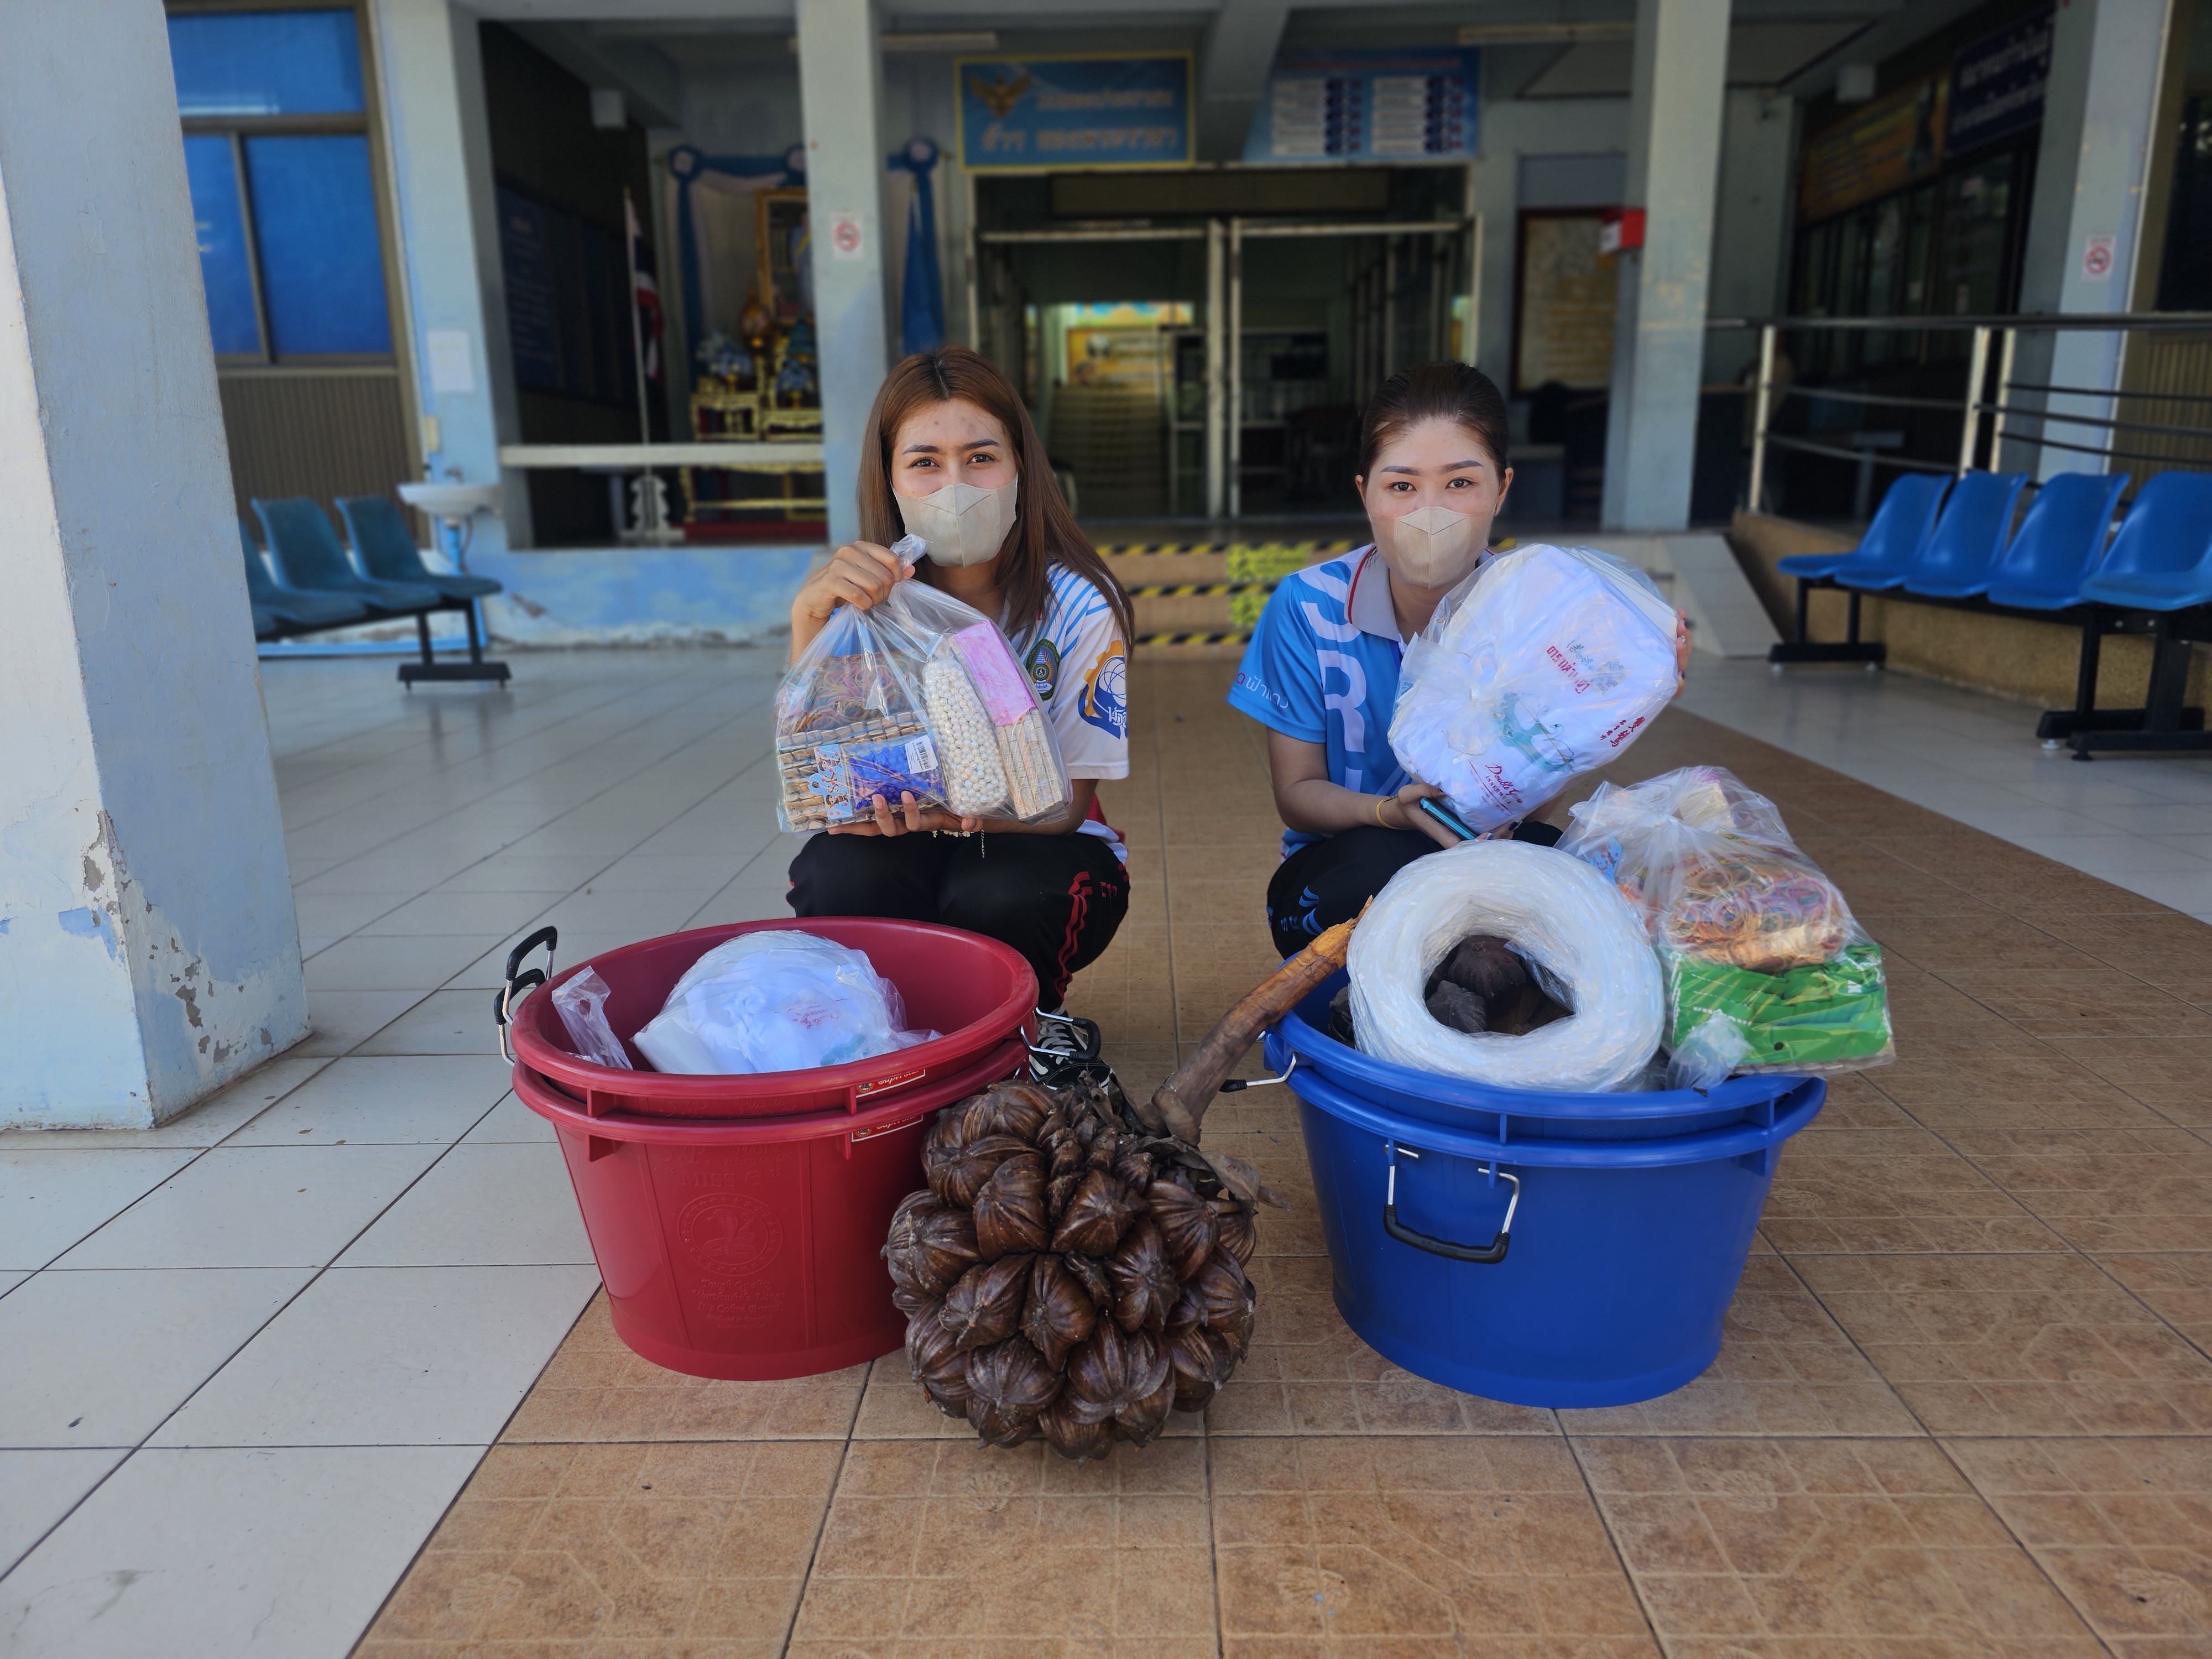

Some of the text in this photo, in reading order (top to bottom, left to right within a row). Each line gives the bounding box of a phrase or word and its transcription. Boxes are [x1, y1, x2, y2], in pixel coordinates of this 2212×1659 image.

[826, 771, 839, 793] SK
[1484, 763, 1514, 790] Double
[701, 1279, 774, 1292] Tough Quality
[691, 1289, 786, 1302] Worthwhile Usage
[697, 1301, 714, 1311] It's
[717, 1303, 747, 1313] Cobra
